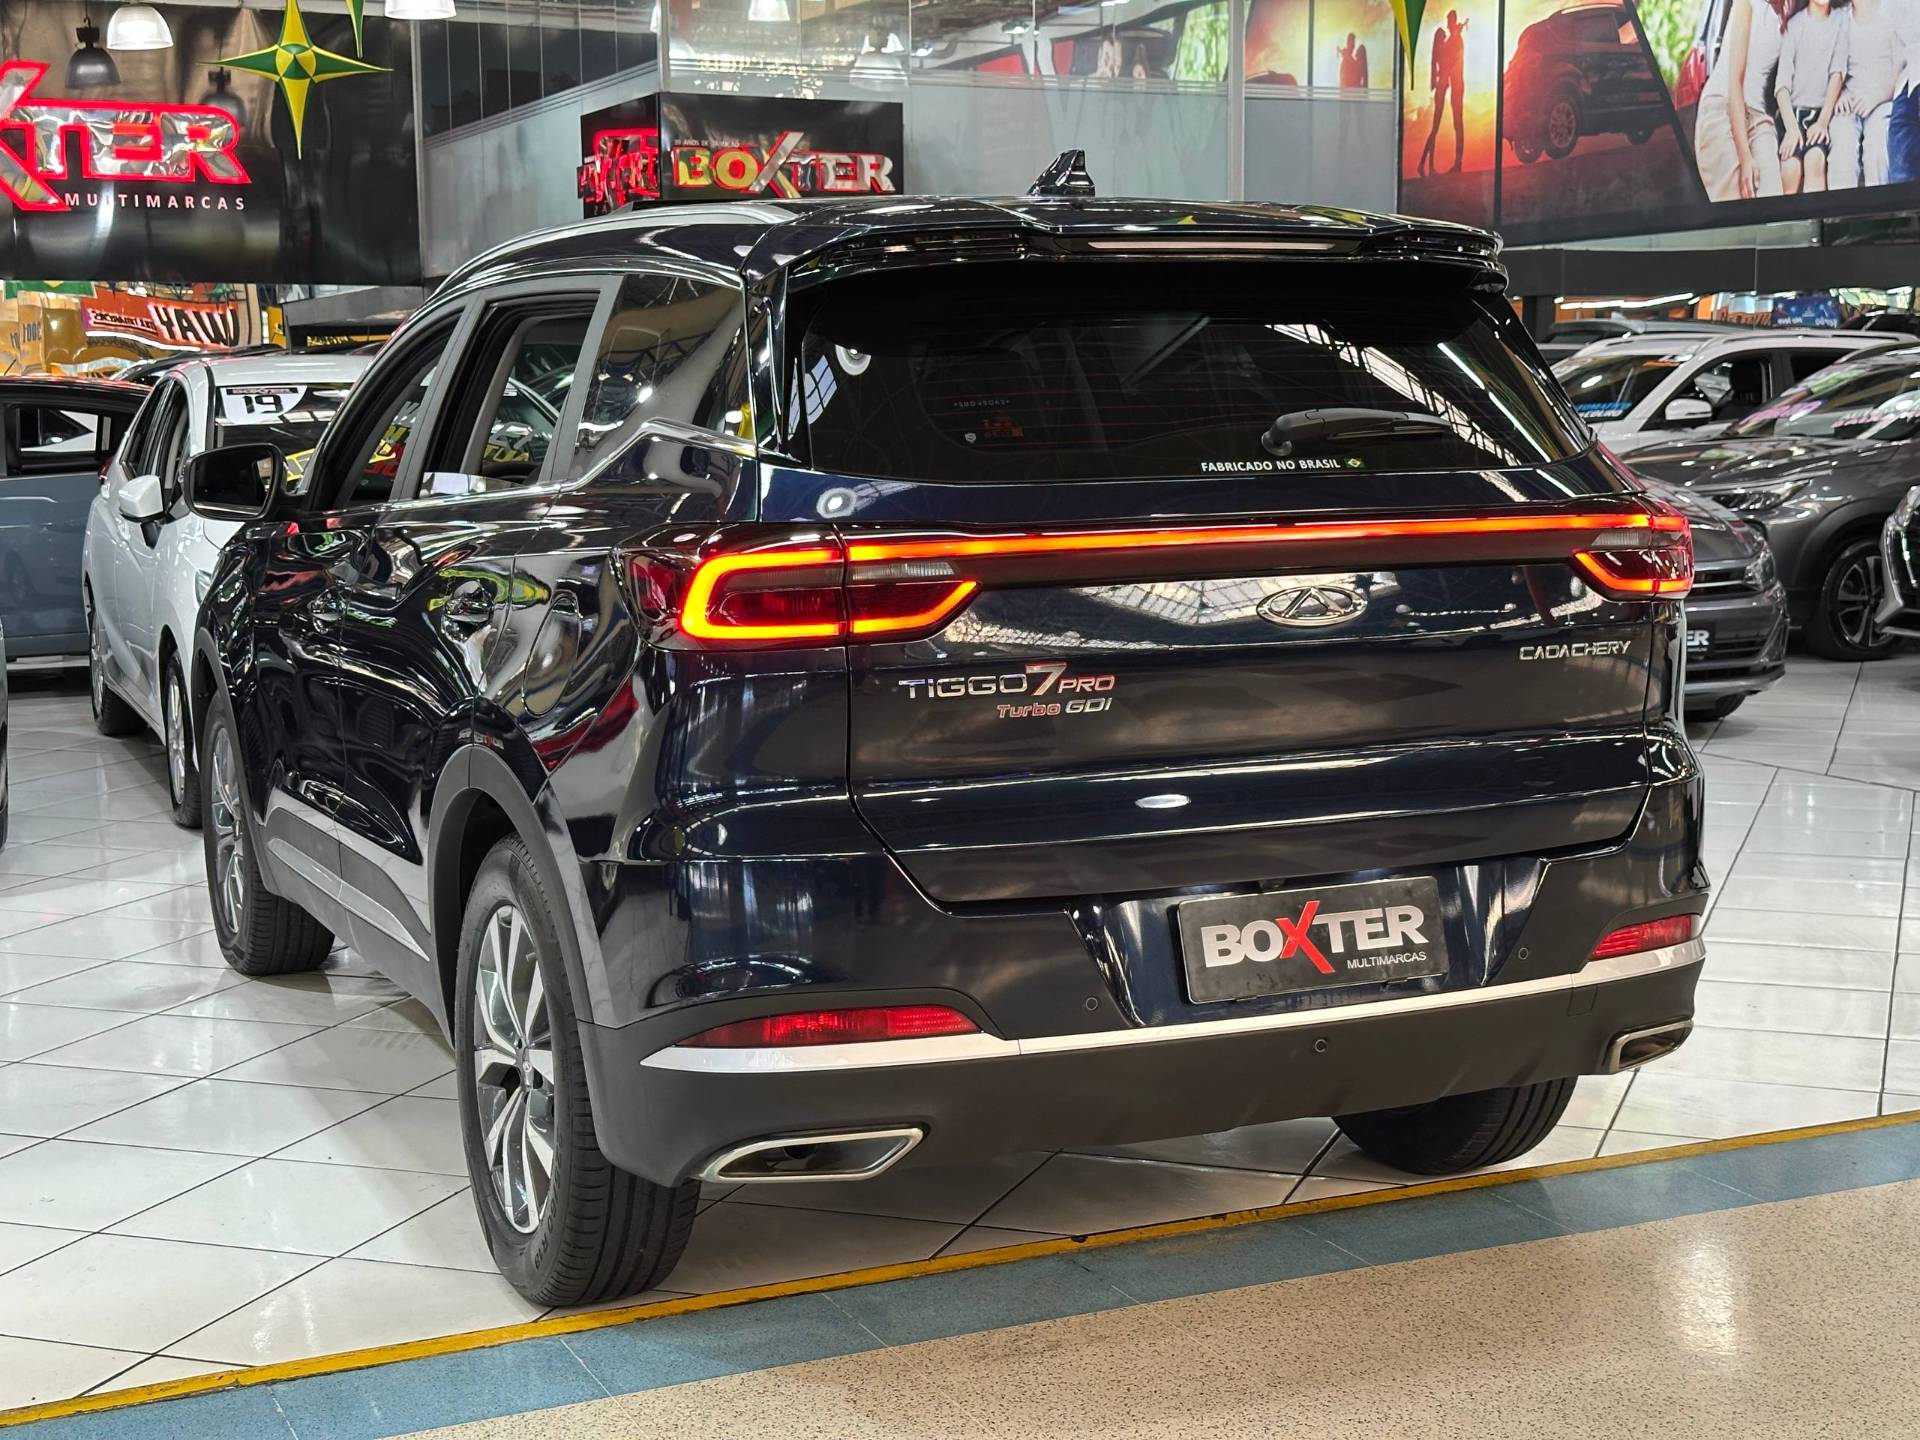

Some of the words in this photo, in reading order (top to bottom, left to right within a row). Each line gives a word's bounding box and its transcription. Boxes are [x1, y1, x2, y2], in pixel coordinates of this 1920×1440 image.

[670, 131, 896, 199] BOXTER
[64, 191, 246, 211] MULTIMARCAS
[1201, 461, 1273, 472] FABRICADO
[1276, 460, 1296, 470] NO
[1298, 459, 1342, 469] BRASIL
[1058, 675, 1116, 694] PRO
[997, 703, 1060, 718] Turbo
[1200, 900, 1430, 974] BOXTER
[1346, 951, 1427, 969] MULTIMARCAS
